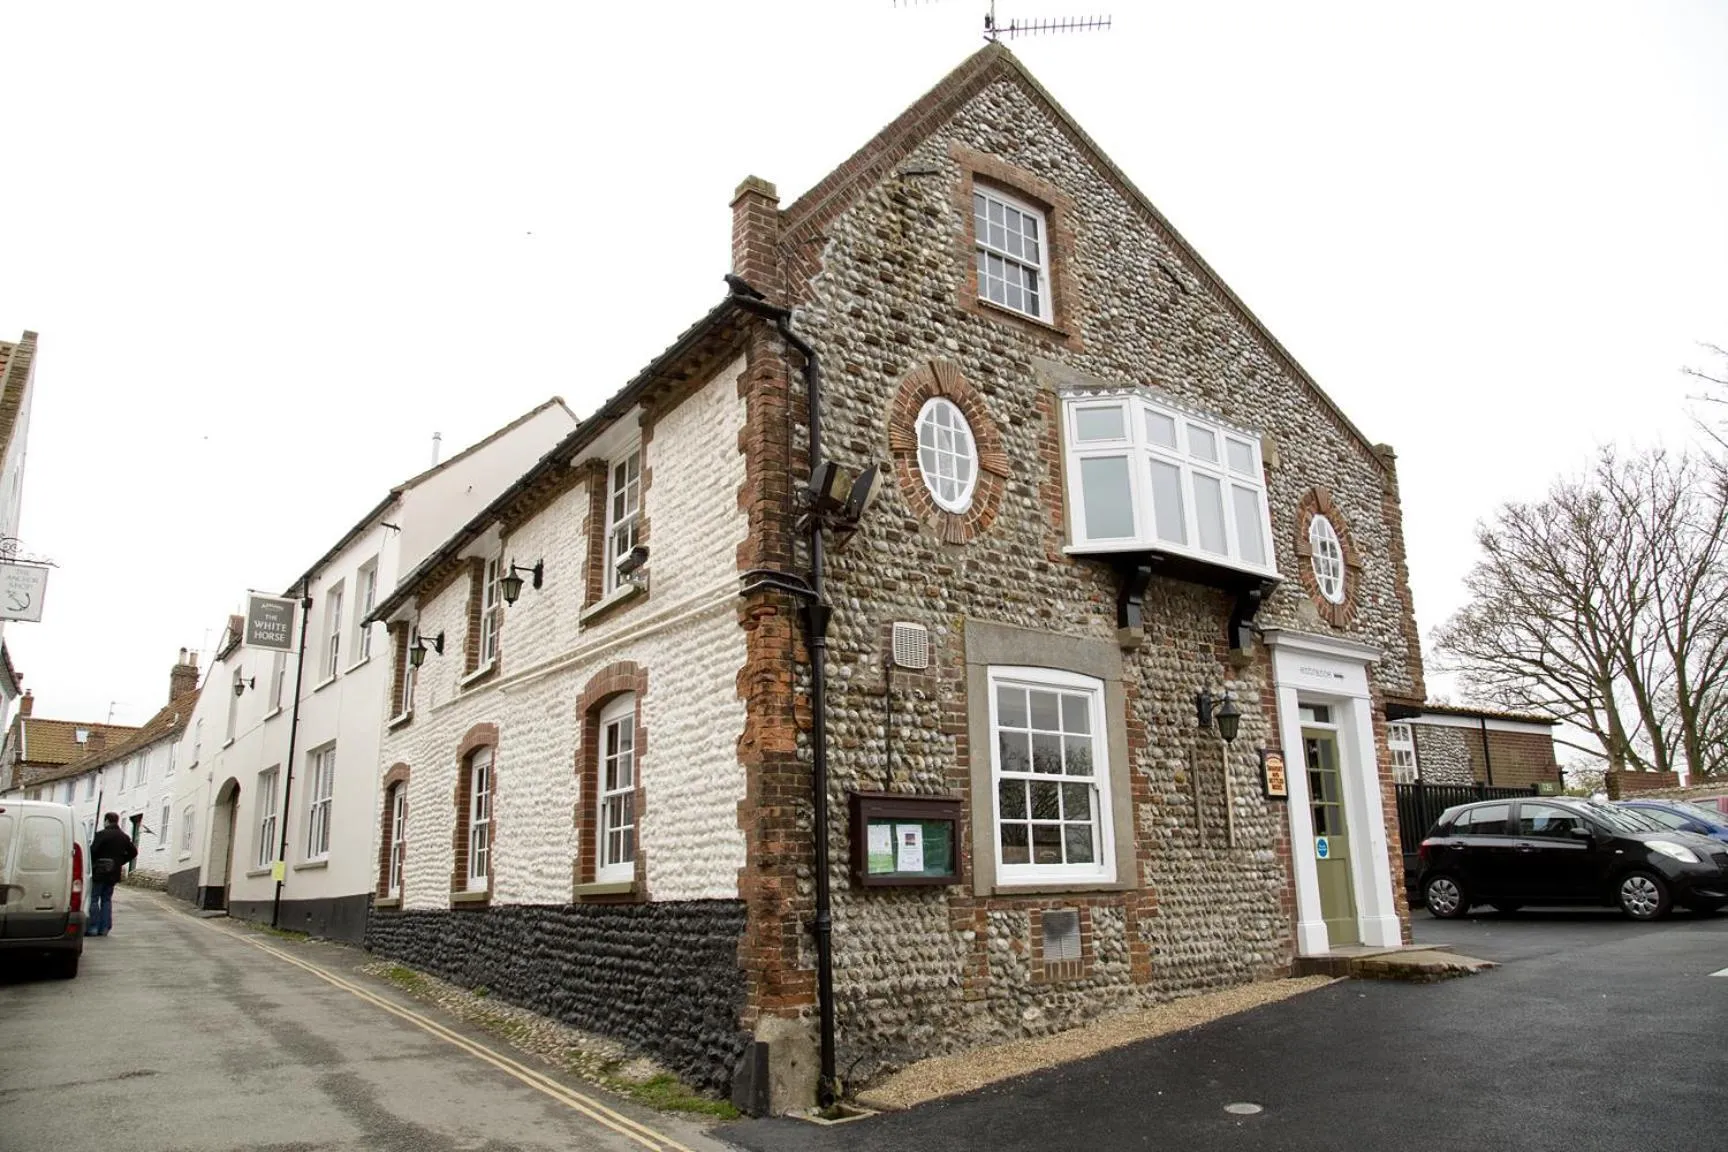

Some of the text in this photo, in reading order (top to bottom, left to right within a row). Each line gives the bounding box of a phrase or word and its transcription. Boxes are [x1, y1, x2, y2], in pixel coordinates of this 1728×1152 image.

[265, 613, 278, 621] THE
[253, 620, 287, 632] WHITE
[253, 630, 287, 642] HORSE
